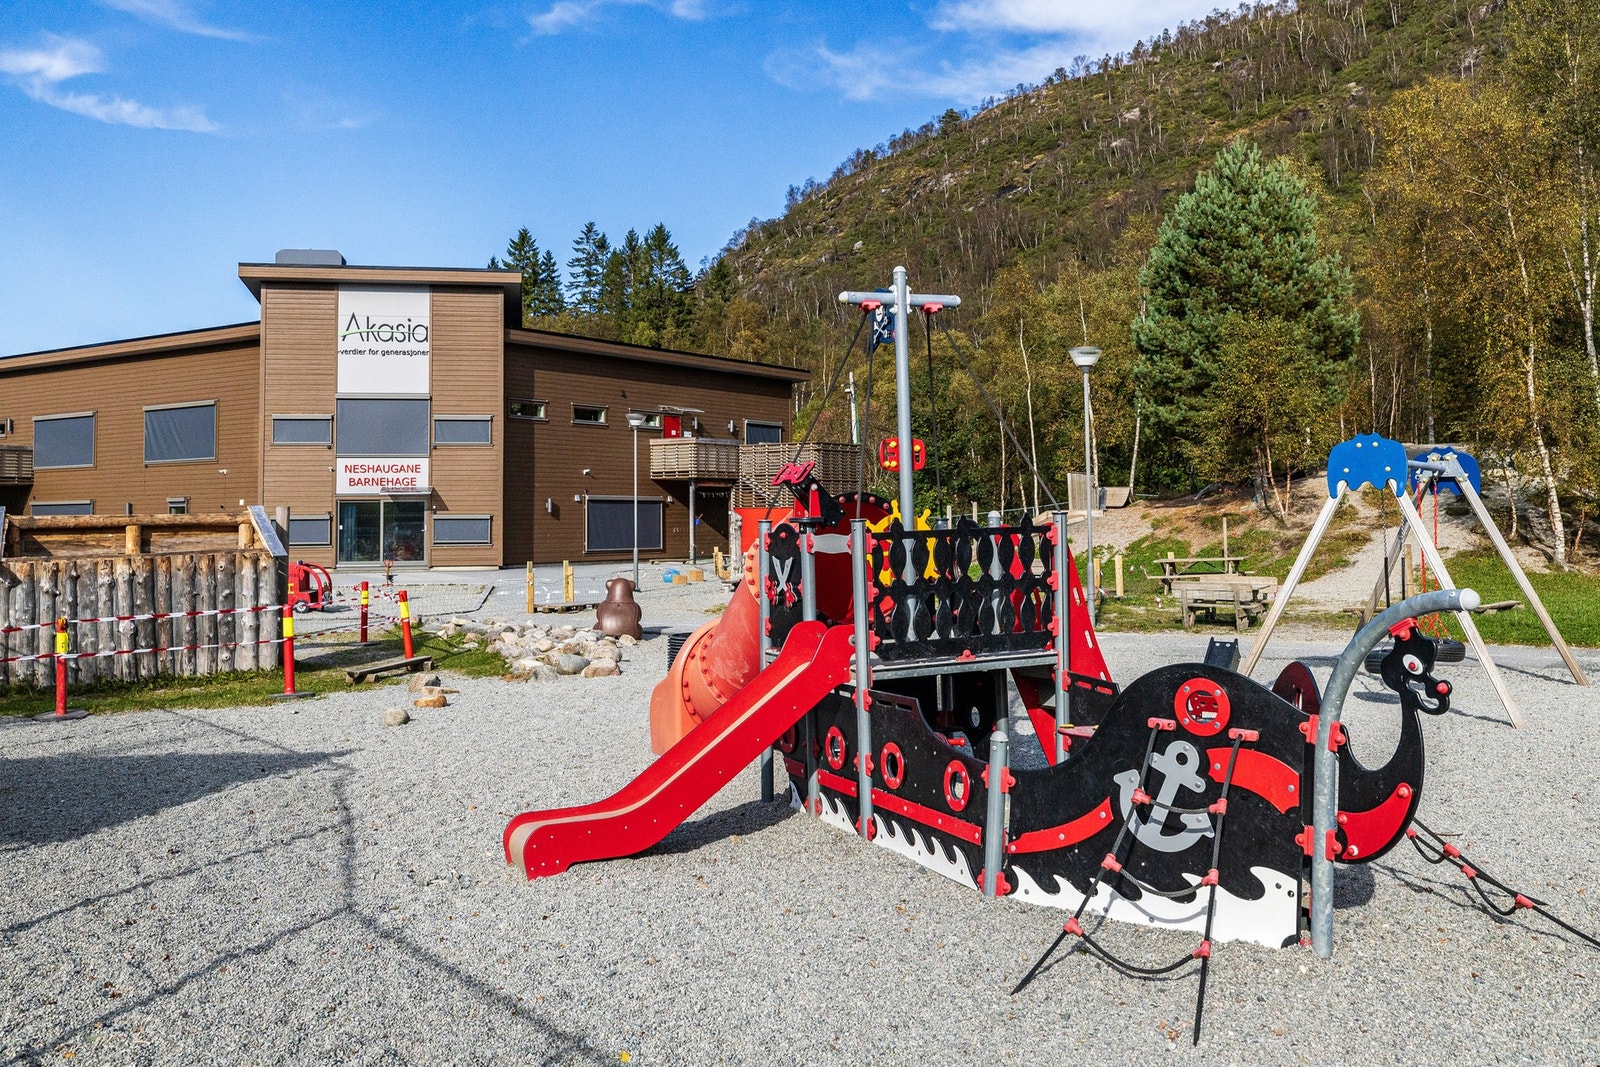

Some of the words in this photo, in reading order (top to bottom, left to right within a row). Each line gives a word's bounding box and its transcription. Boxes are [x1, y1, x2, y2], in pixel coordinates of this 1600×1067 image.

[341, 312, 428, 343] Akasia
[381, 349, 429, 357] generasjoner
[344, 464, 421, 474] NESHAUGANE
[348, 477, 417, 487] BARNEHAGE
